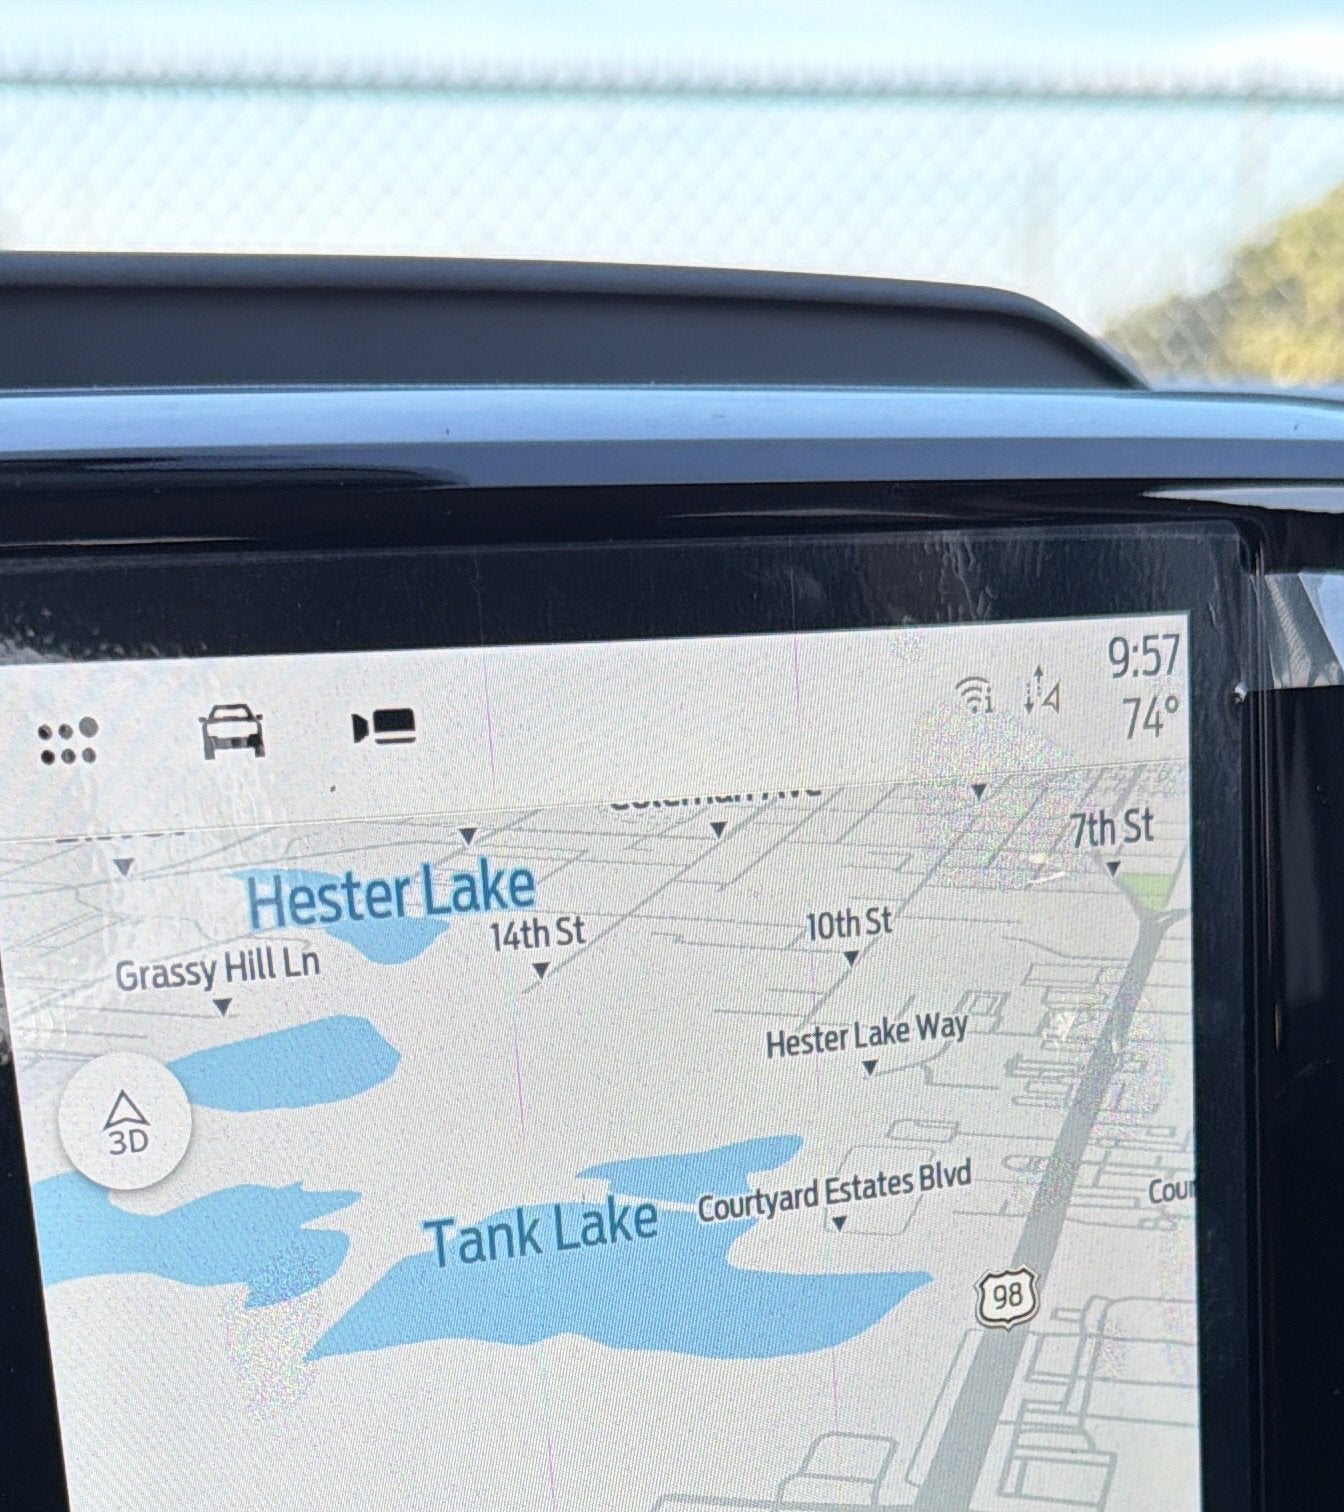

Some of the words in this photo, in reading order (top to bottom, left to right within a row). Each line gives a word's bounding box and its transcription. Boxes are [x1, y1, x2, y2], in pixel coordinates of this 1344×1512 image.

[1108, 633, 1181, 679] 9:57
[1122, 694, 1180, 740] 74°
[1070, 813, 1116, 849] 7th
[1124, 807, 1155, 844] St
[247, 871, 410, 930] Hester
[423, 856, 536, 916] Lake
[491, 921, 550, 952] 14th
[557, 915, 587, 947] St
[806, 909, 861, 941] 10th
[865, 906, 894, 936] St
[116, 955, 216, 993] Grassy
[225, 948, 277, 983] Hill
[284, 947, 321, 976] Ln
[766, 1026, 849, 1058] Hester
[854, 1020, 910, 1050] Lake
[915, 1013, 970, 1043] Way
[108, 1128, 149, 1157] 3D
[698, 1179, 820, 1223] Courtyard
[825, 1171, 914, 1205] Estates
[919, 1159, 972, 1191] Blvd
[422, 1202, 543, 1269] Tank
[555, 1195, 658, 1251] Lake
[992, 1283, 1024, 1311] 98
